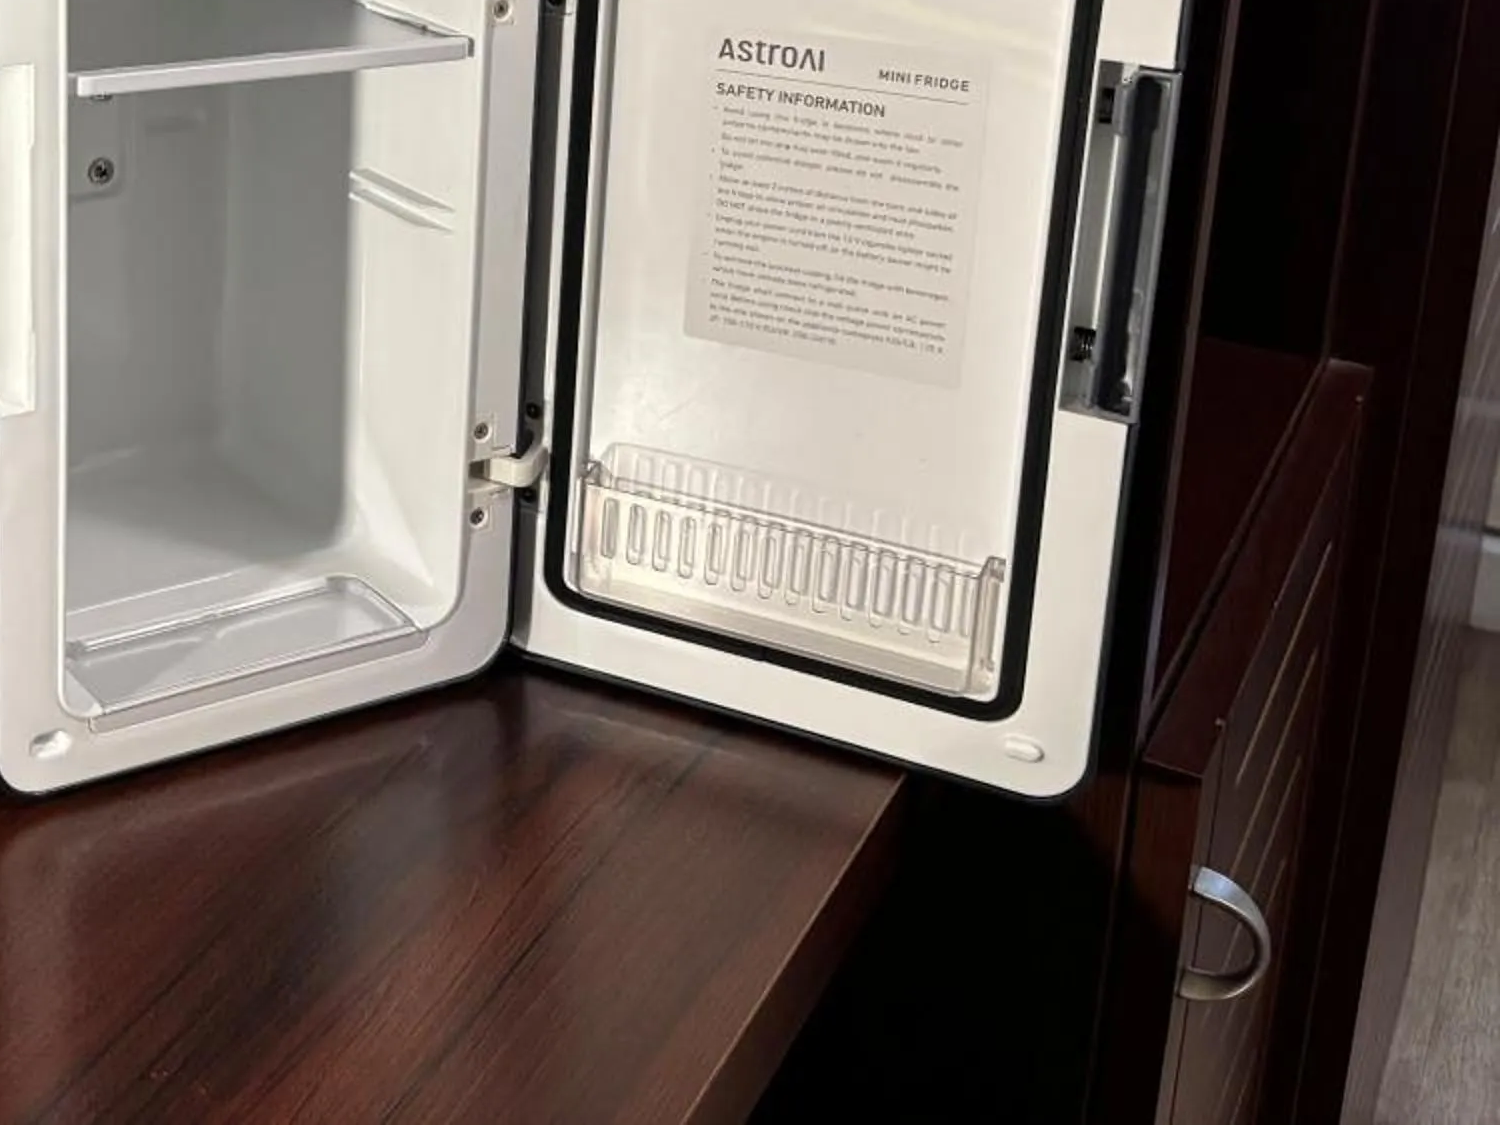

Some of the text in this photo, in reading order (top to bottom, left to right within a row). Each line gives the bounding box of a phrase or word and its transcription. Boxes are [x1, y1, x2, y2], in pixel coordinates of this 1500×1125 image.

[878, 68, 970, 93] MINI FRIDGE
[716, 82, 886, 118] SAFETY INFORMATION
